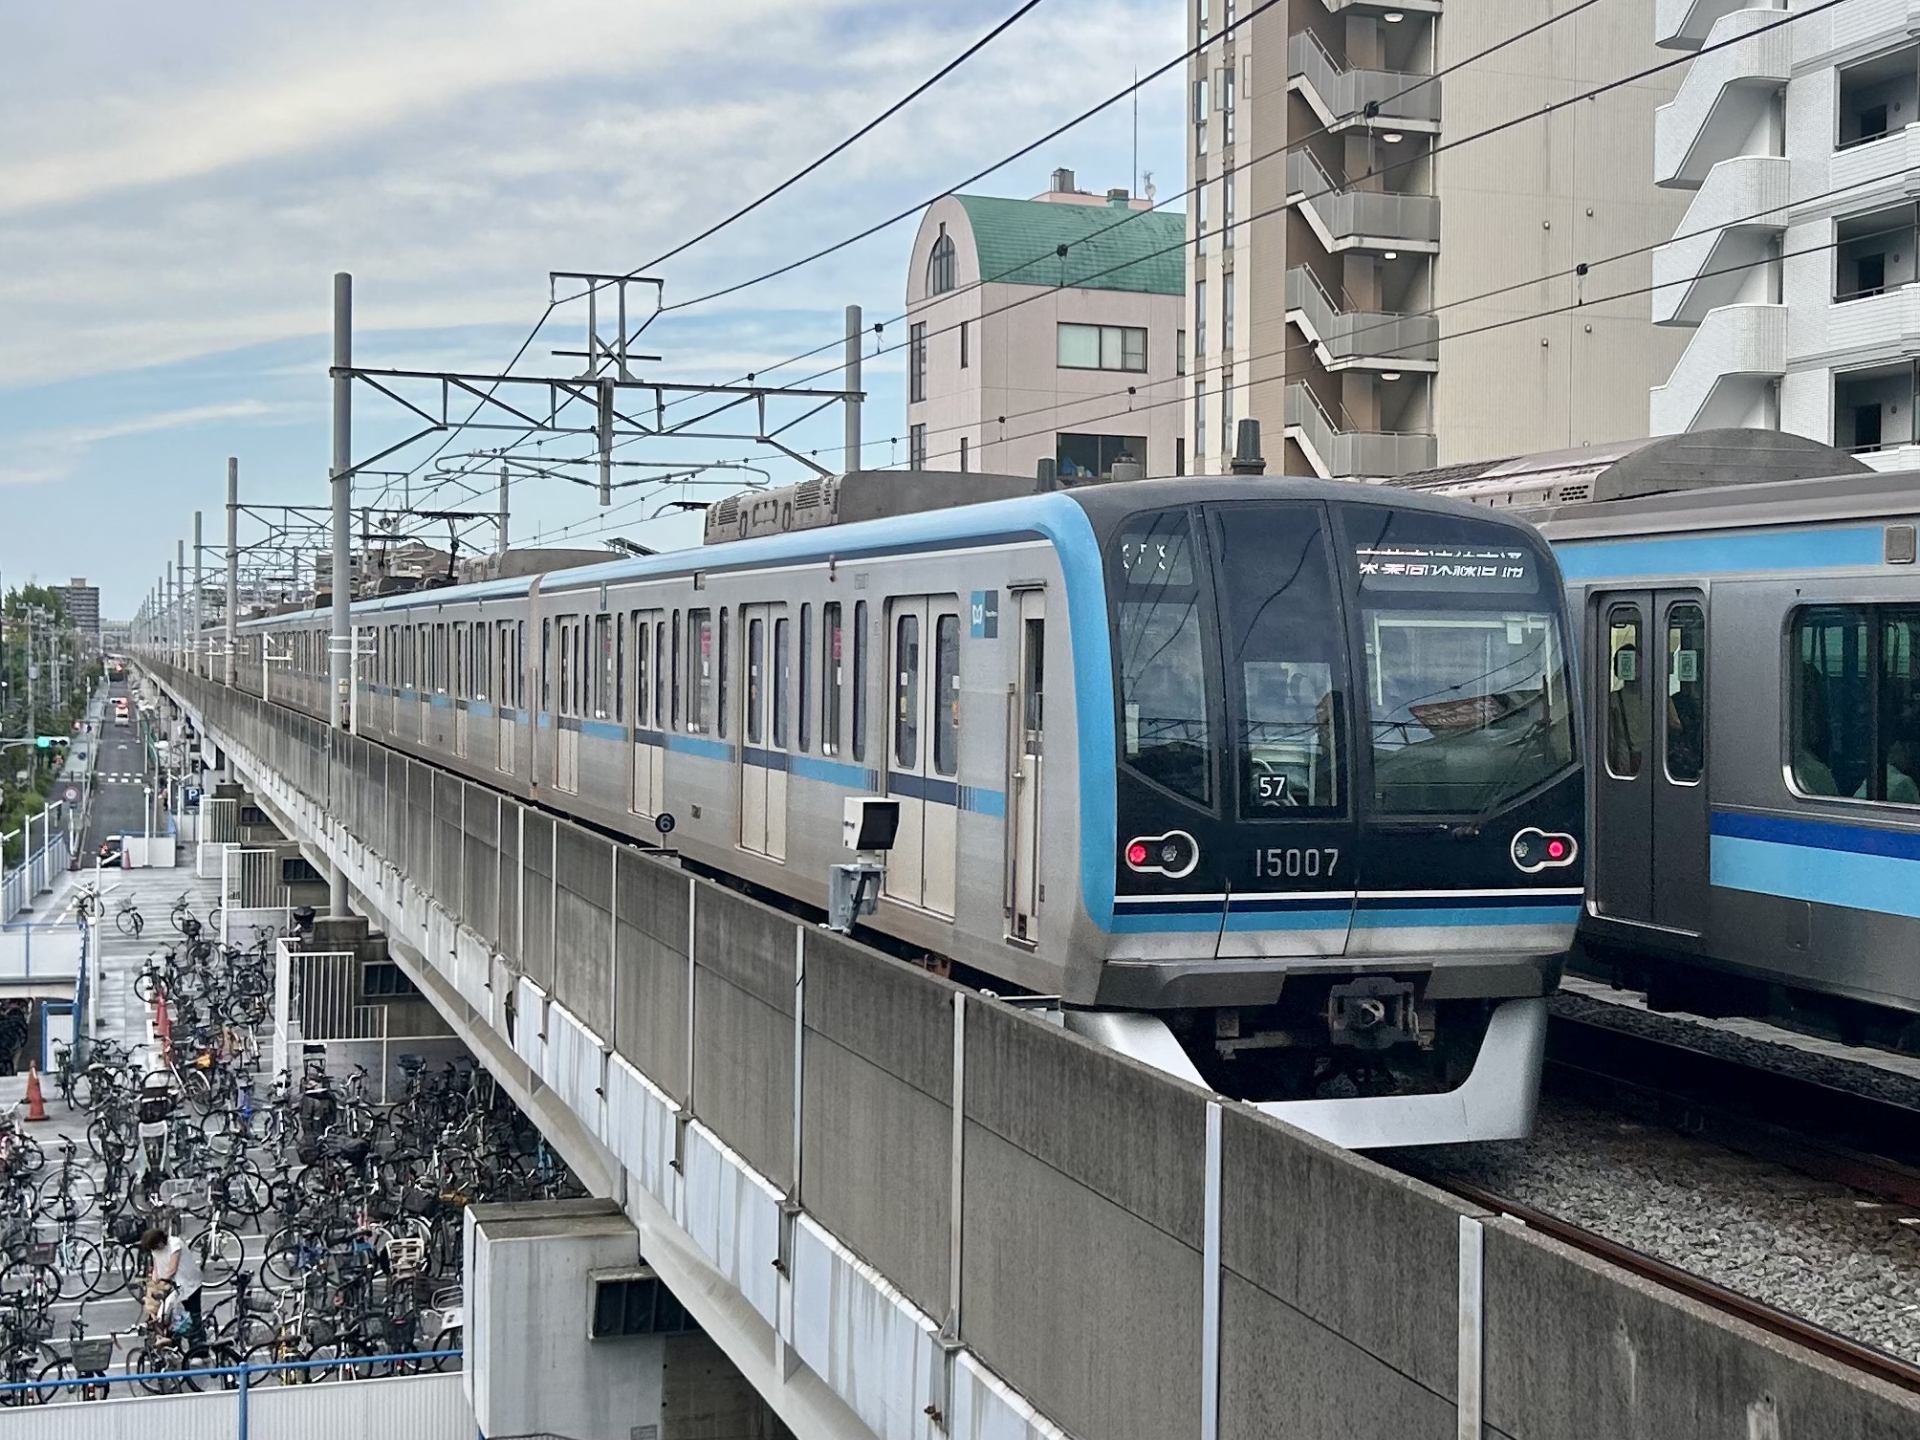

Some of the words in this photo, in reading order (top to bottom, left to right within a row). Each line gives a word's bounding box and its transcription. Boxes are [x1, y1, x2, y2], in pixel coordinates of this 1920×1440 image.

[188, 789, 198, 800] P
[1259, 776, 1286, 798] 57
[659, 815, 671, 831] 6
[1256, 848, 1339, 877] 15007
